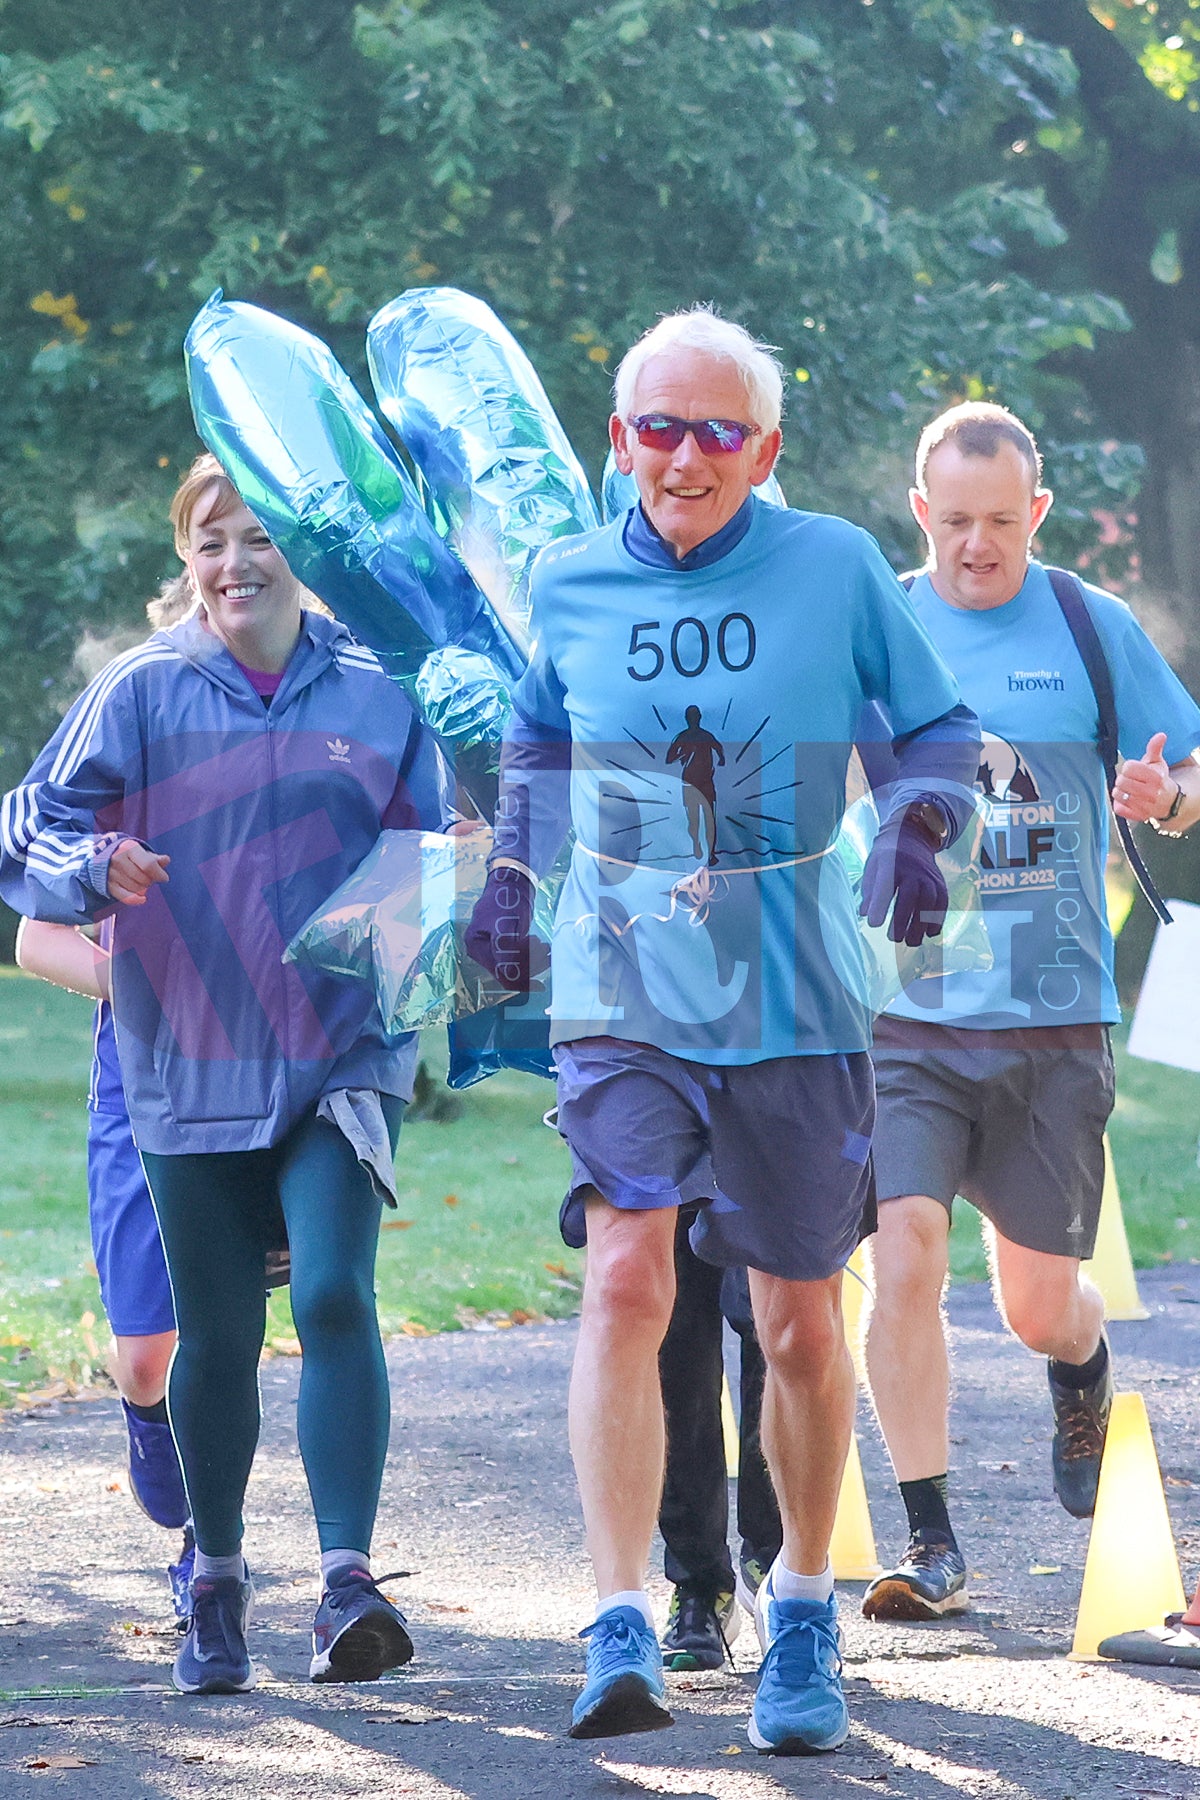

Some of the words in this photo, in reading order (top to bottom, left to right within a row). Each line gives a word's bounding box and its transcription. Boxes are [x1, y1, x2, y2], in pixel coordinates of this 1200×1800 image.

[560, 544, 588, 559] JAKO
[627, 612, 756, 681] 500
[1014, 669, 1052, 680] Timothy
[1007, 676, 1065, 691] brown
[1019, 869, 1056, 886] 2023
